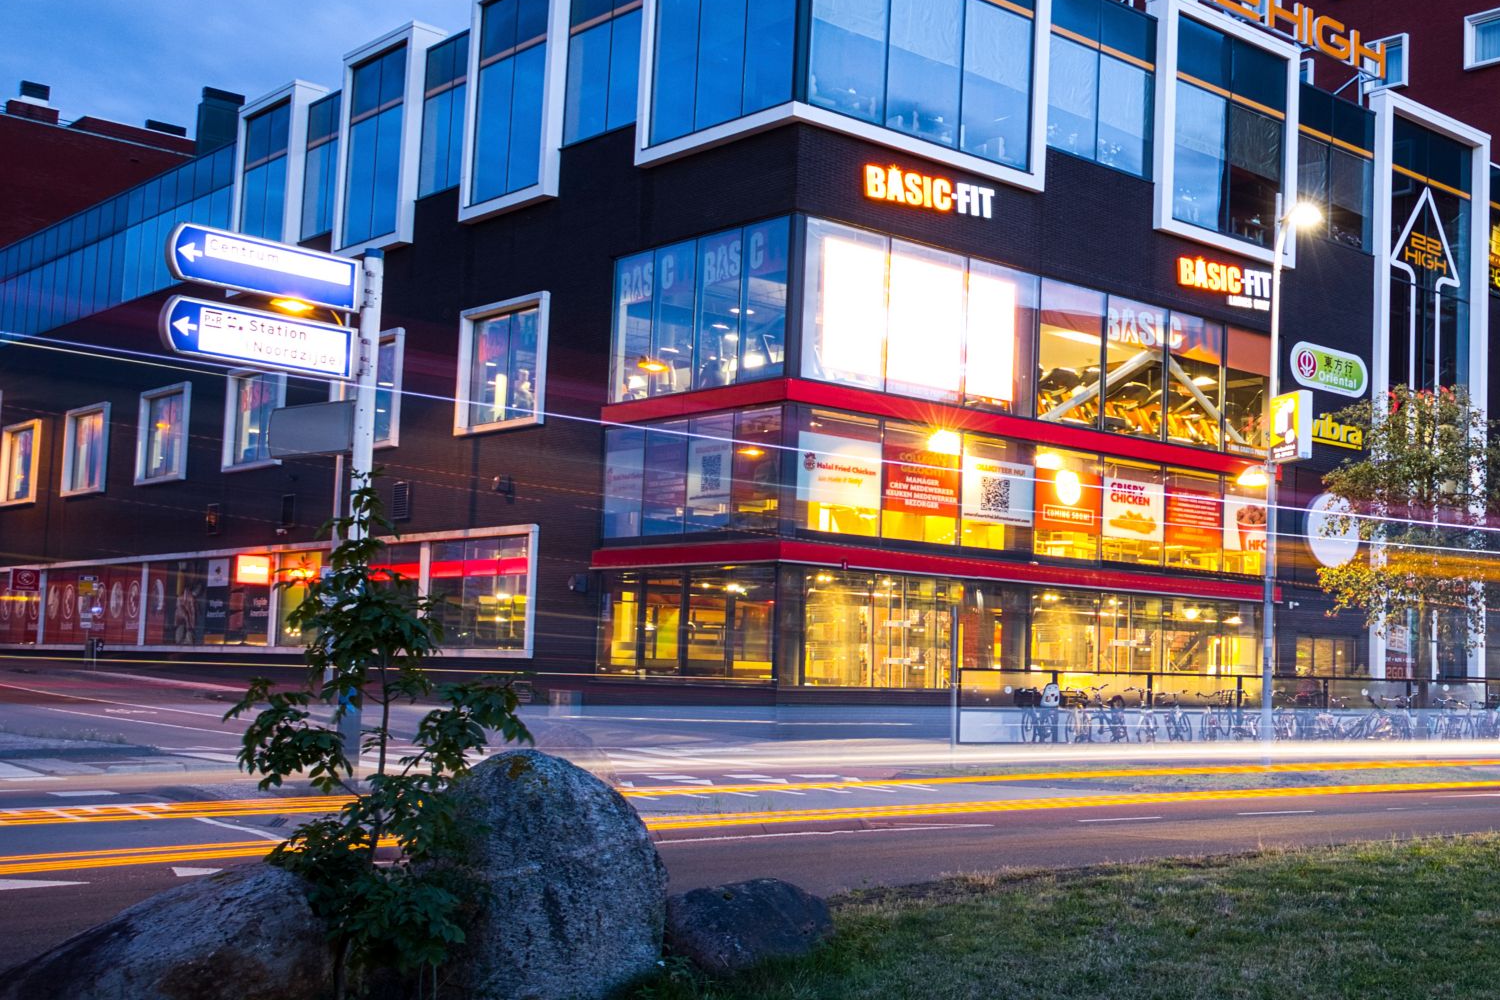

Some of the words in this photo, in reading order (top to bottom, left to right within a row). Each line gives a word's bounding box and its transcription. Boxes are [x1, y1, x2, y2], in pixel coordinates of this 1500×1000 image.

[864, 163, 995, 218] BASIC-FIT
[210, 238, 279, 263] Centrum
[1411, 231, 1442, 256] 22
[1405, 246, 1447, 275] HIGH
[1178, 256, 1272, 298] BASIC-FIT
[250, 319, 307, 341] Station
[1319, 370, 1357, 389] Oriental
[817, 462, 833, 470] Halal
[835, 465, 851, 473] Fried
[852, 467, 876, 476] Chicken
[906, 476, 939, 486] MANAGER
[910, 484, 954, 495] MEDEWERKER
[1111, 493, 1150, 506] CHICKEN
